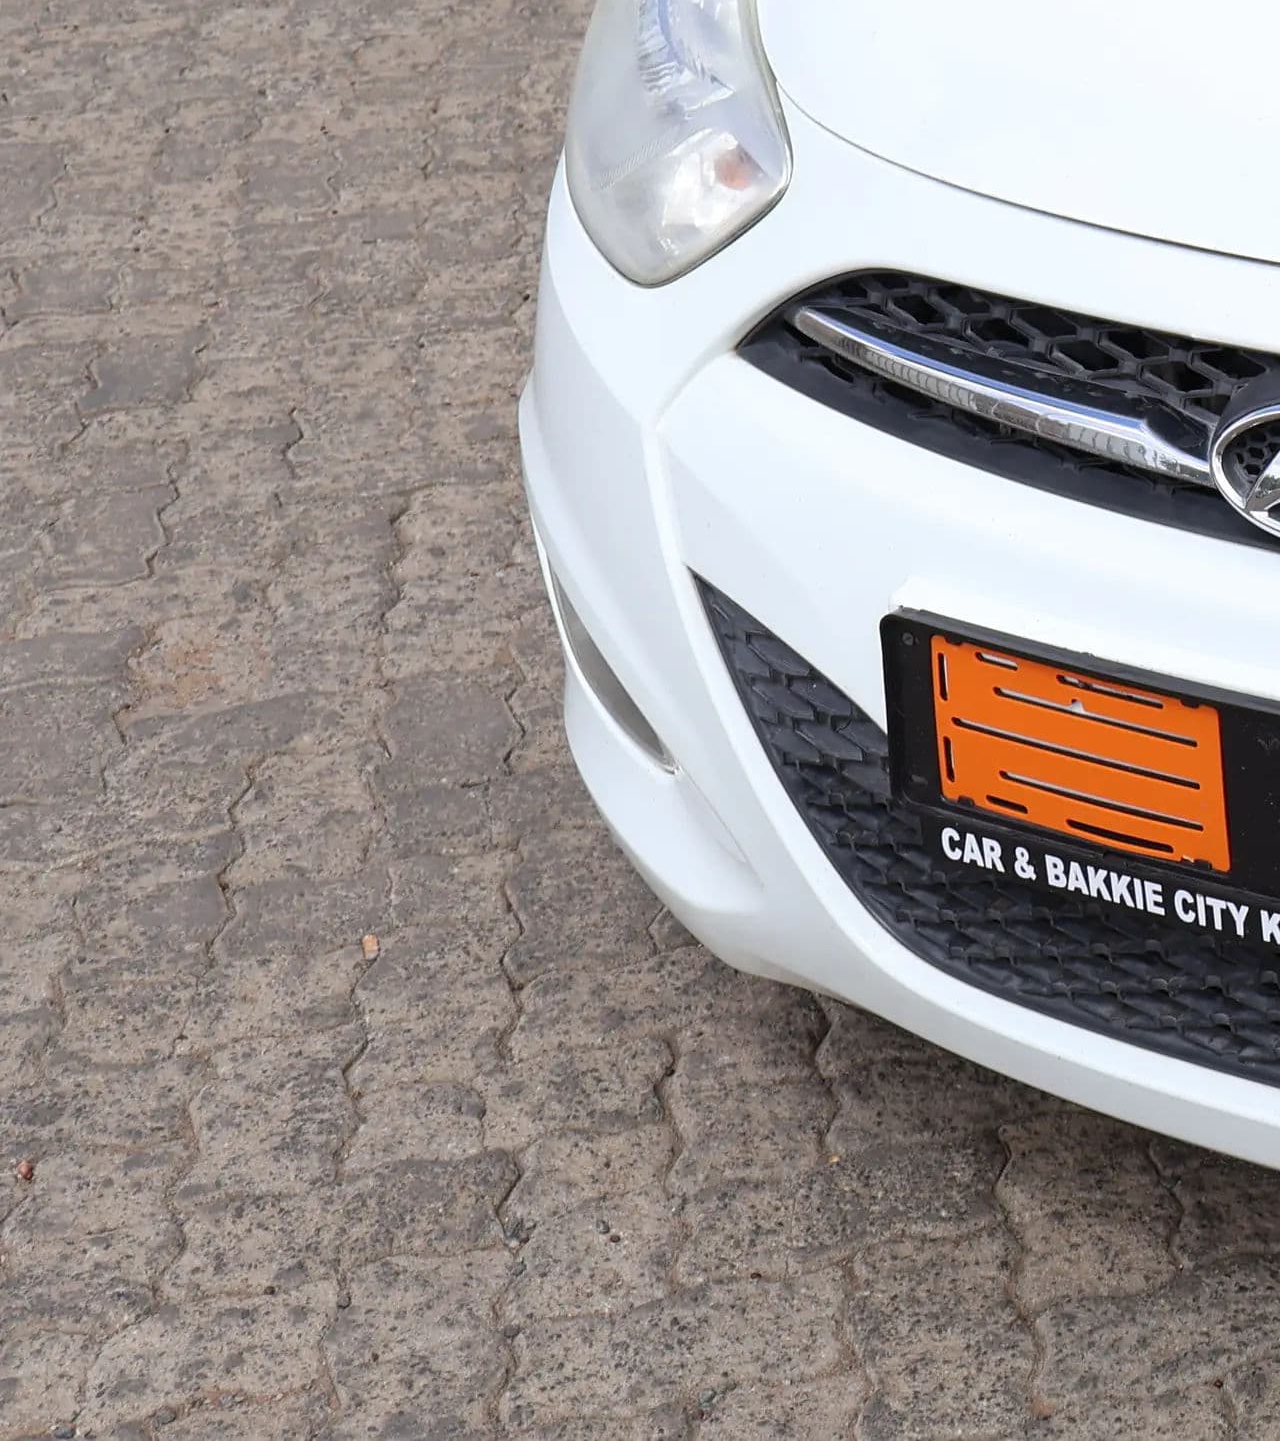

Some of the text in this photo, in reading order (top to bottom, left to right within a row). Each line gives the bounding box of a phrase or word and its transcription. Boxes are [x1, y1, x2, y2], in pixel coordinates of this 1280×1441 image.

[940, 826, 1005, 874] CAR
[1013, 846, 1037, 881] &
[1044, 853, 1166, 916] BAKKIE
[1173, 889, 1250, 937] CITY
